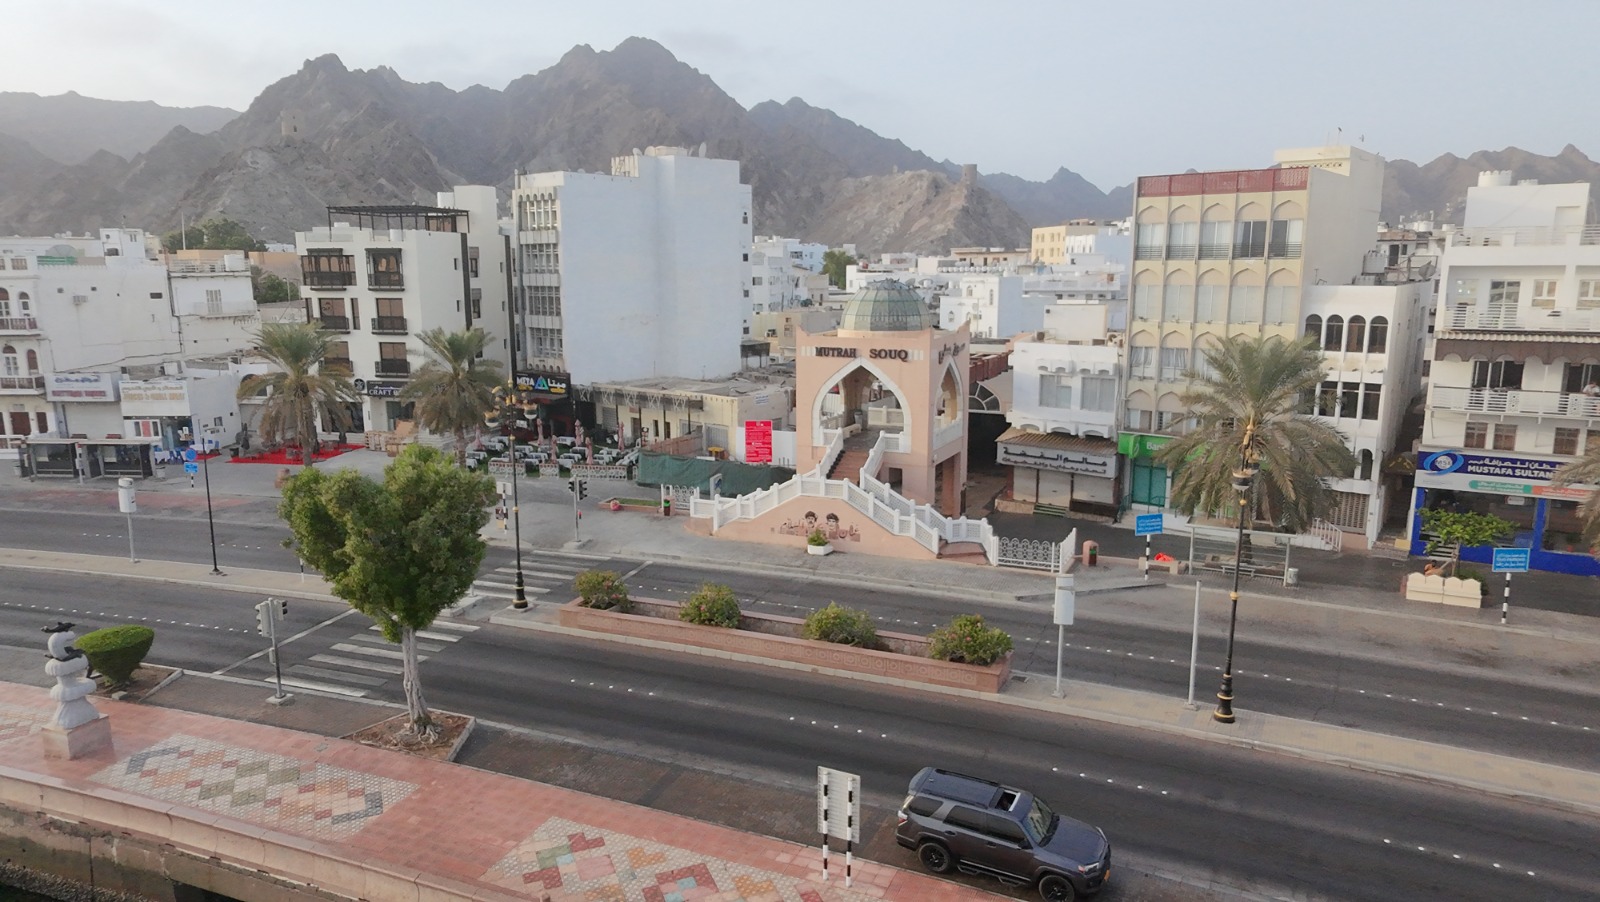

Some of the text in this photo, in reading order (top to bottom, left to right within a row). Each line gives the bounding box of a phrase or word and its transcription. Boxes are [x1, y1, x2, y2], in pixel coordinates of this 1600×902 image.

[815, 347, 909, 362] MUTRAH SOUQ
[516, 376, 535, 386] META
[1467, 465, 1555, 479] MUSTAFA SULTAN
